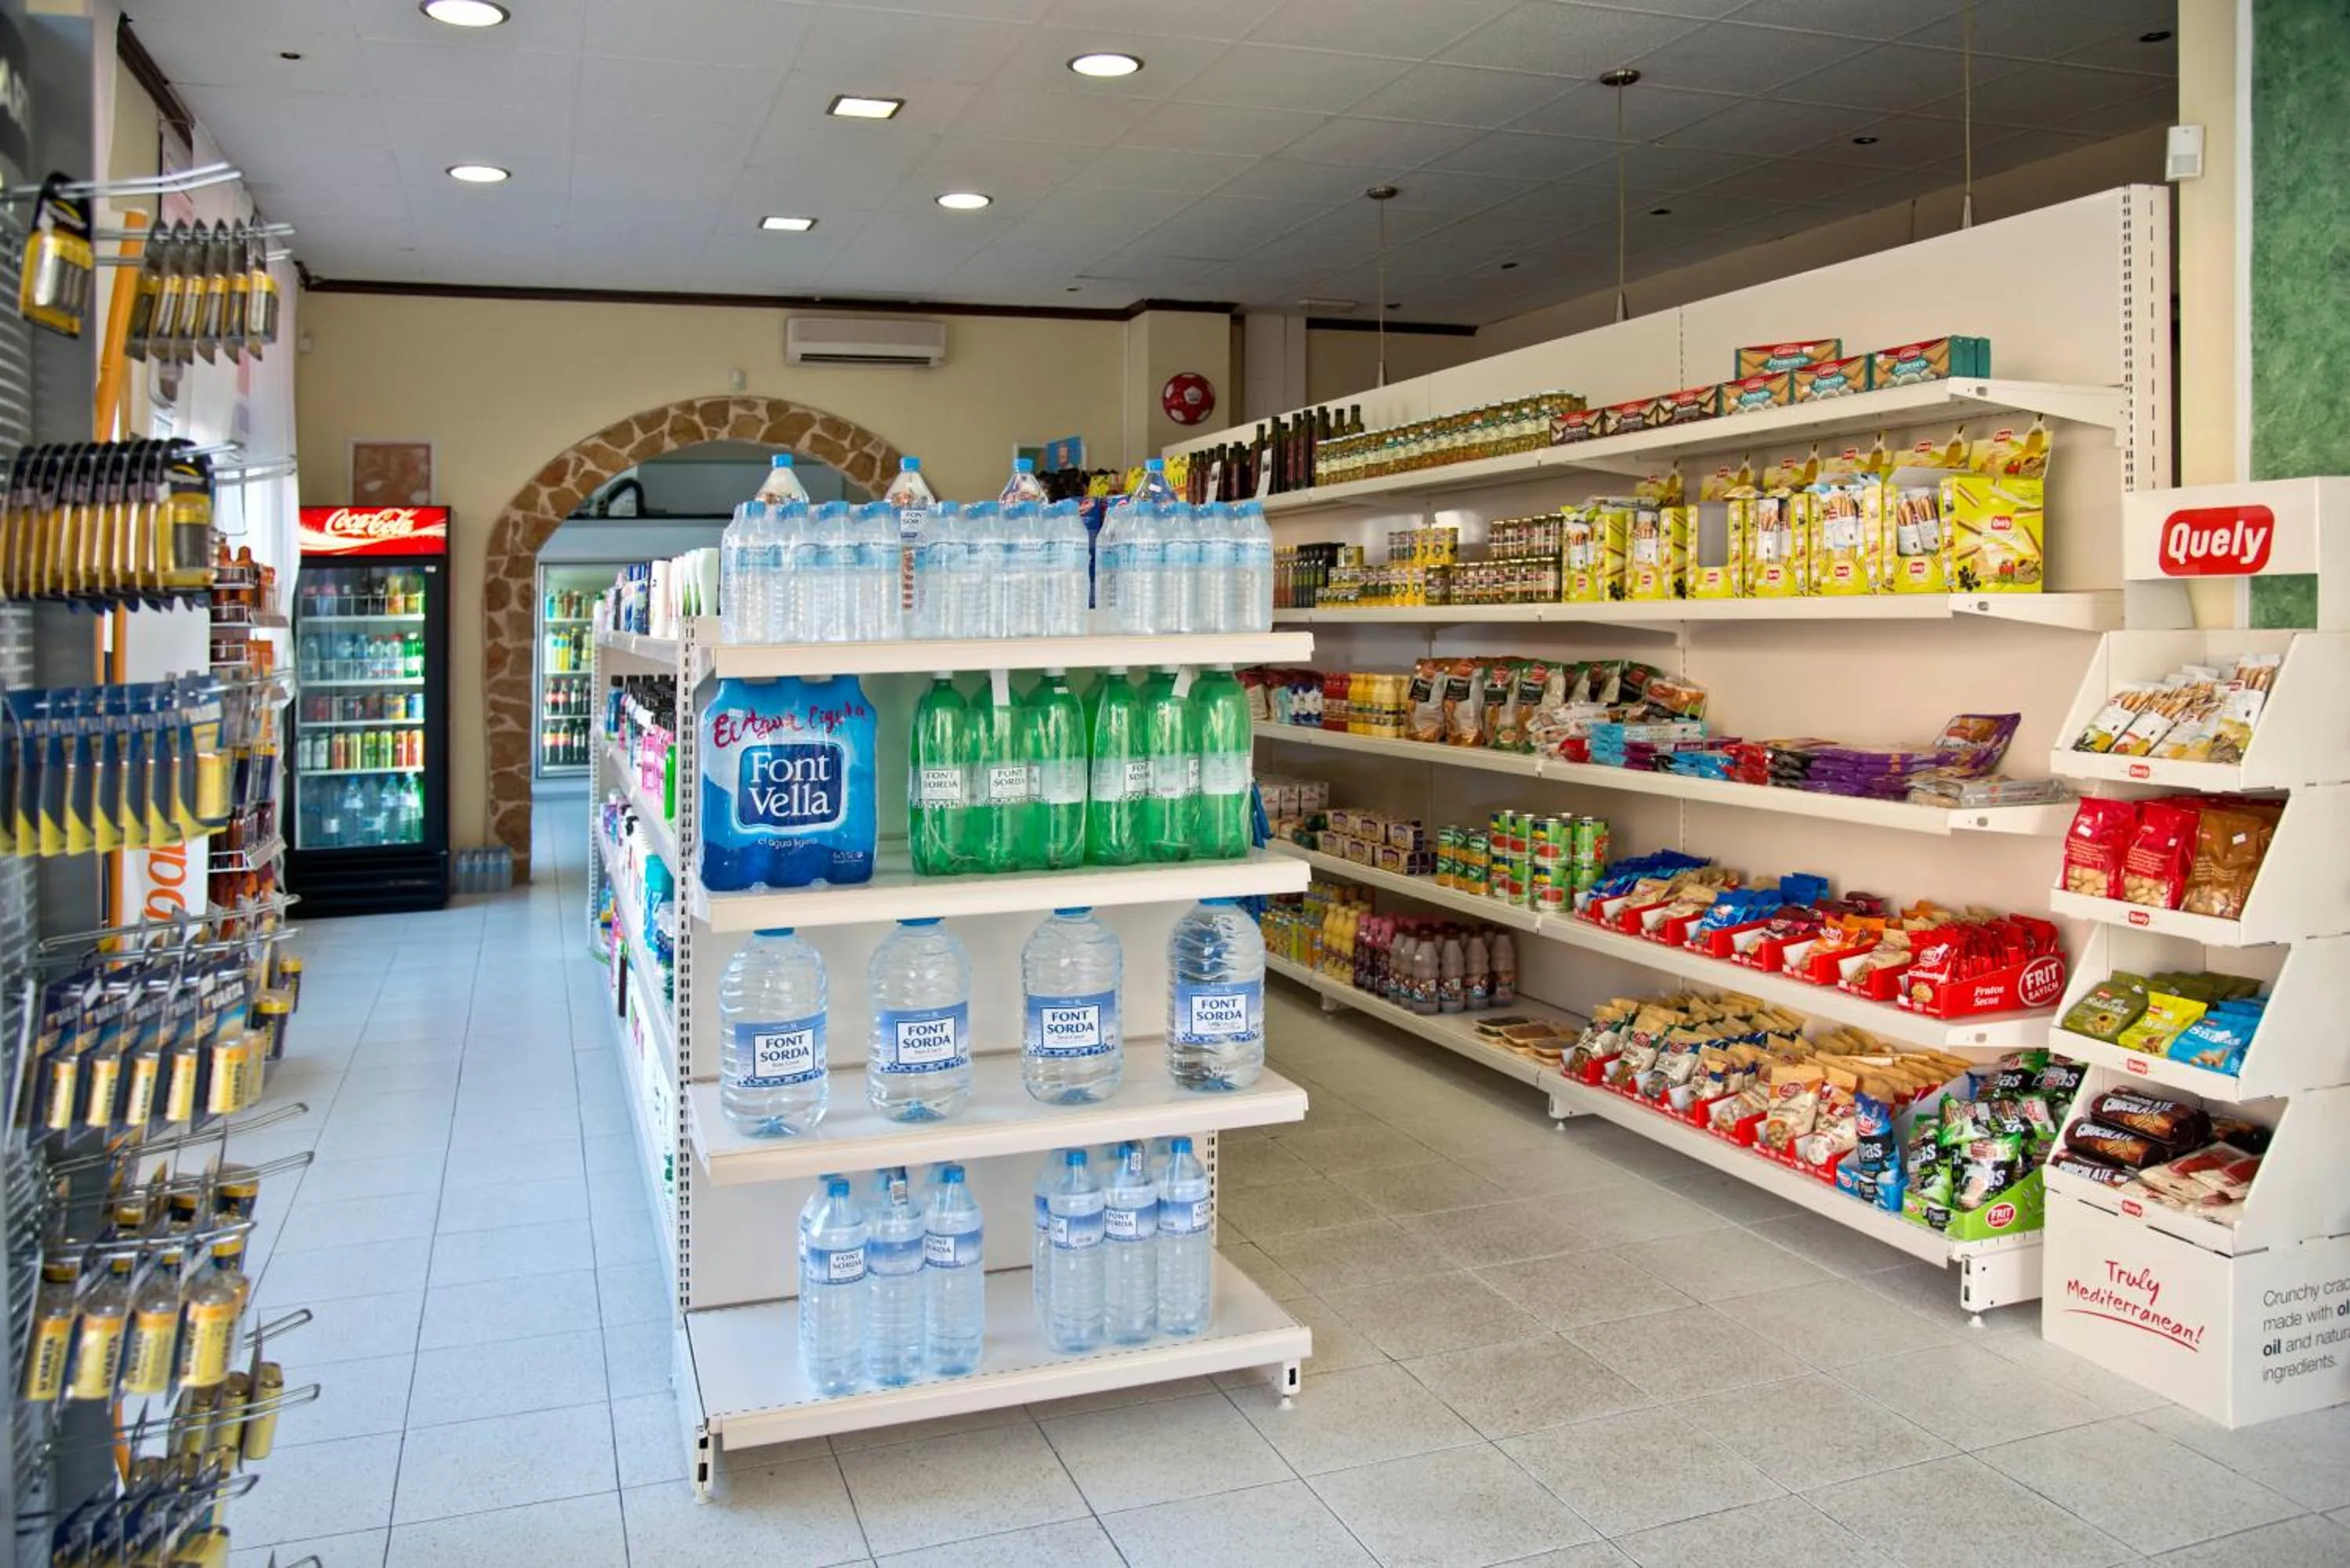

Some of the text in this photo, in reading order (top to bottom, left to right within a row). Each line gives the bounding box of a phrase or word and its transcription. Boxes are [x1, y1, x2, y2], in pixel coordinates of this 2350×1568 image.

[324, 508, 421, 538] Coca-Cola
[2167, 520, 2268, 565] Quely
[750, 752, 832, 783] Font
[748, 783, 833, 818] Vella
[2024, 962, 2059, 991] FRIT
[1973, 985, 2005, 997] Frutos
[1973, 997, 2000, 1007] Secos
[1051, 1010, 1090, 1022] FONT
[1195, 1010, 1242, 1021] SORDA
[1201, 998, 1238, 1010] FONT
[907, 1022, 947, 1036] FONT
[1047, 1022, 1095, 1035] SORDA
[765, 1033, 805, 1050] FONT
[902, 1035, 952, 1050] SORDA
[759, 1046, 810, 1064] SORDA
[2105, 1259, 2160, 1306] Truly
[2263, 1283, 2320, 1307] Crunchy
[2066, 1279, 2205, 1344] Mediterranean!
[2263, 1311, 2302, 1332] made
[2305, 1303, 2334, 1323] with
[2262, 1327, 2350, 1357] oil and natur
[2261, 1353, 2338, 1384] ingredients.
